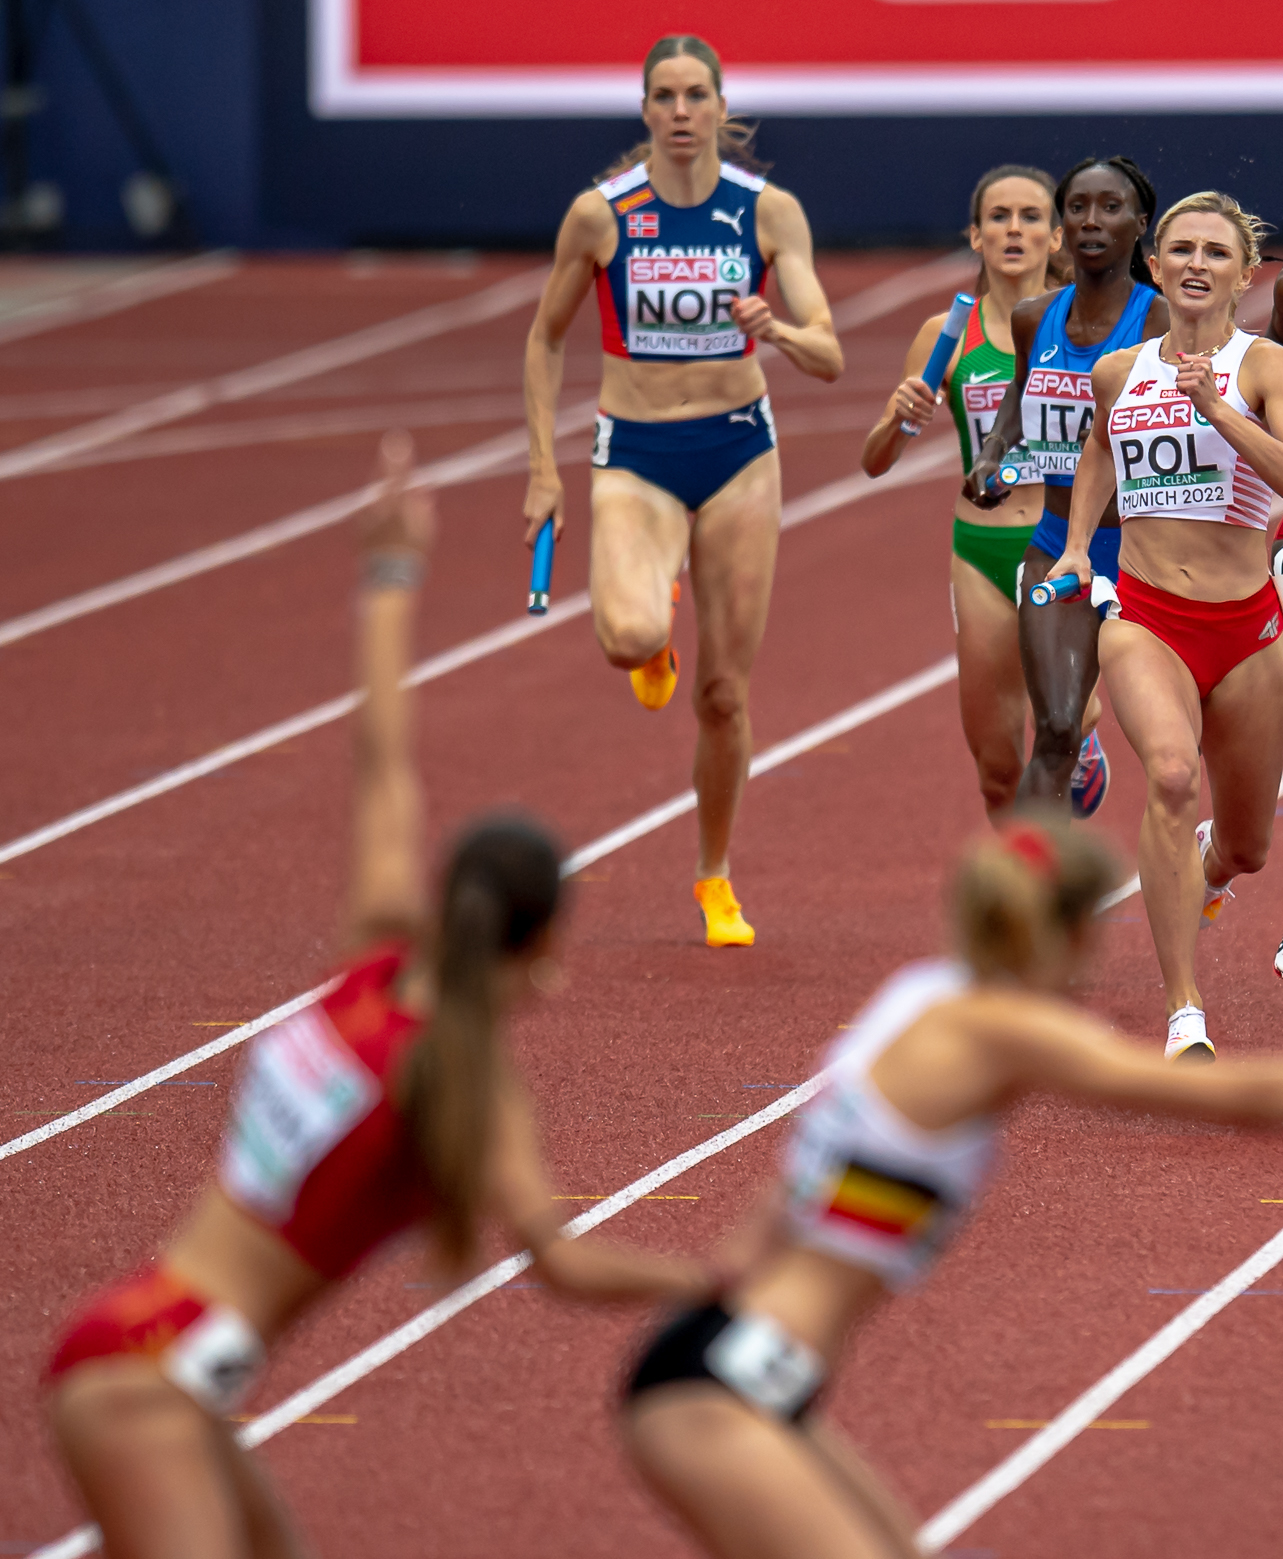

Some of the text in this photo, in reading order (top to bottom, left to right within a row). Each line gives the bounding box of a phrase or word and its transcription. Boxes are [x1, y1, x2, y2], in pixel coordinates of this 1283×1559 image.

[631, 260, 716, 281] SPAR
[636, 288, 741, 324] NOR
[635, 334, 739, 350] MUNICH 2022
[1028, 373, 1094, 398] SPAR
[967, 388, 1006, 409] SP
[1112, 403, 1190, 431] SPAR
[1049, 443, 1070, 452] RUN
[1120, 433, 1218, 480] POL
[1142, 478, 1161, 488] RUN
[1122, 486, 1225, 511] MUNICH 2022
